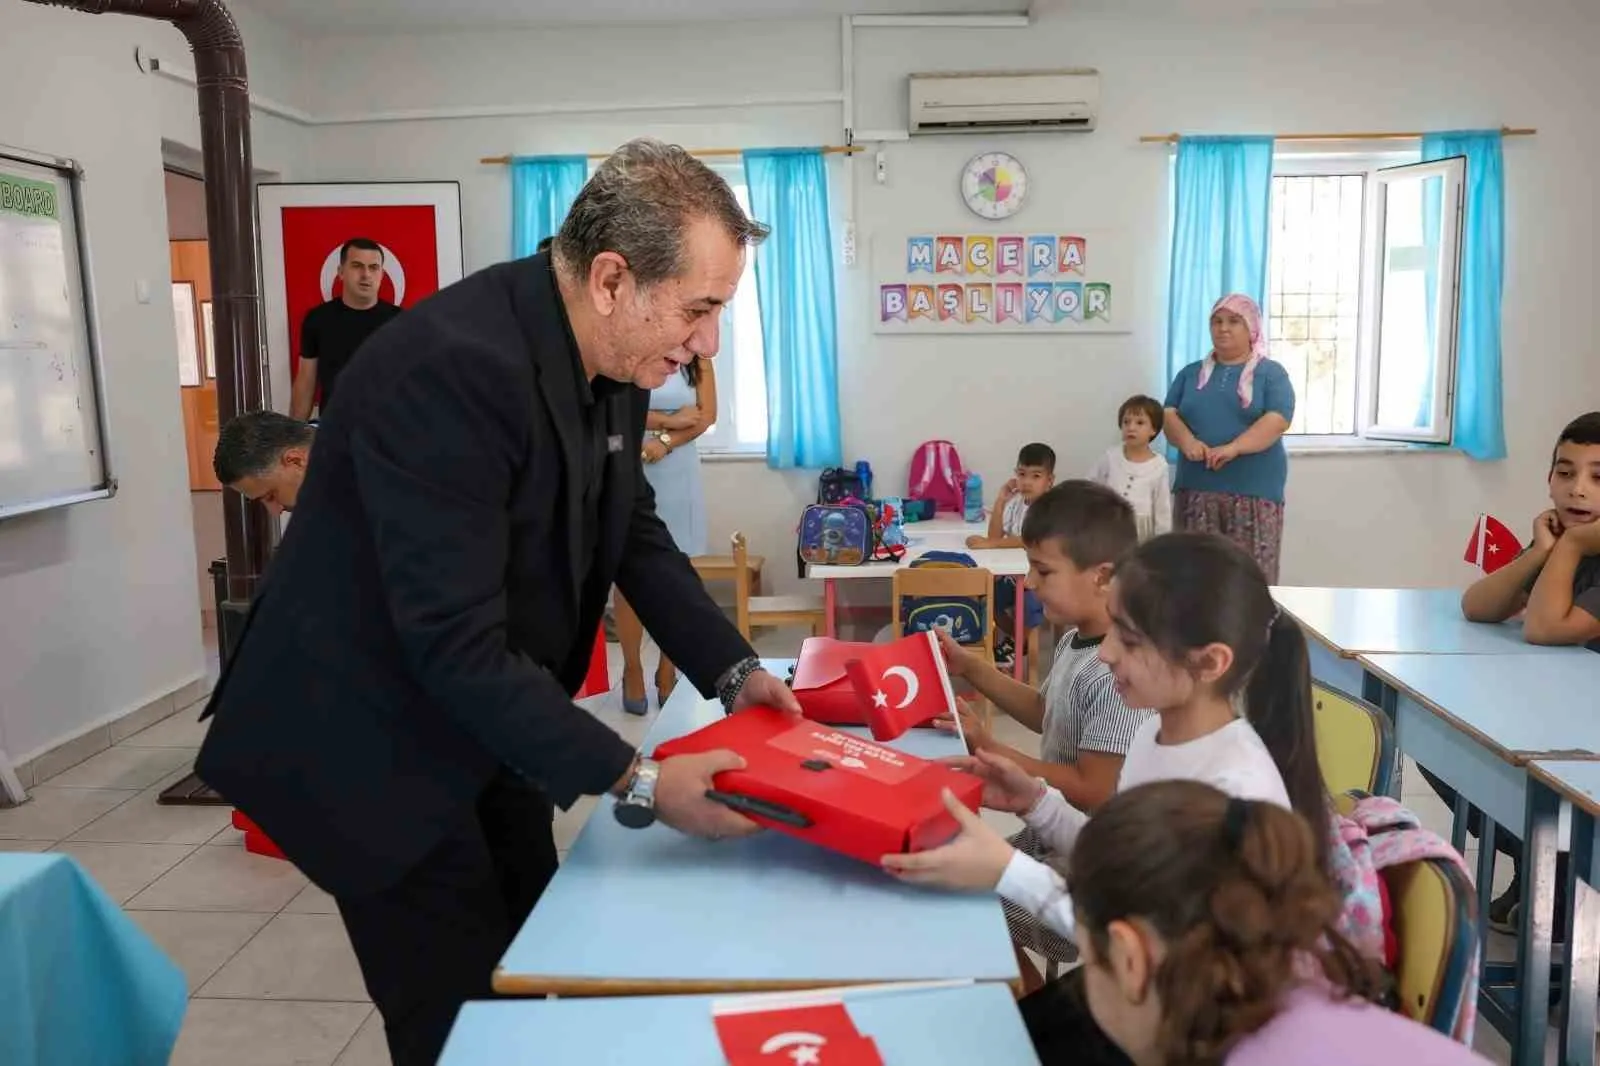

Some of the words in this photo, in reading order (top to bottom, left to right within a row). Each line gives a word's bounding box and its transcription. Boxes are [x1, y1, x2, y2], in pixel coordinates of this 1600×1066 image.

[0, 181, 55, 216] BOARD
[910, 242, 1084, 268] MACERA
[885, 288, 1106, 314] BAŞLIYOR
